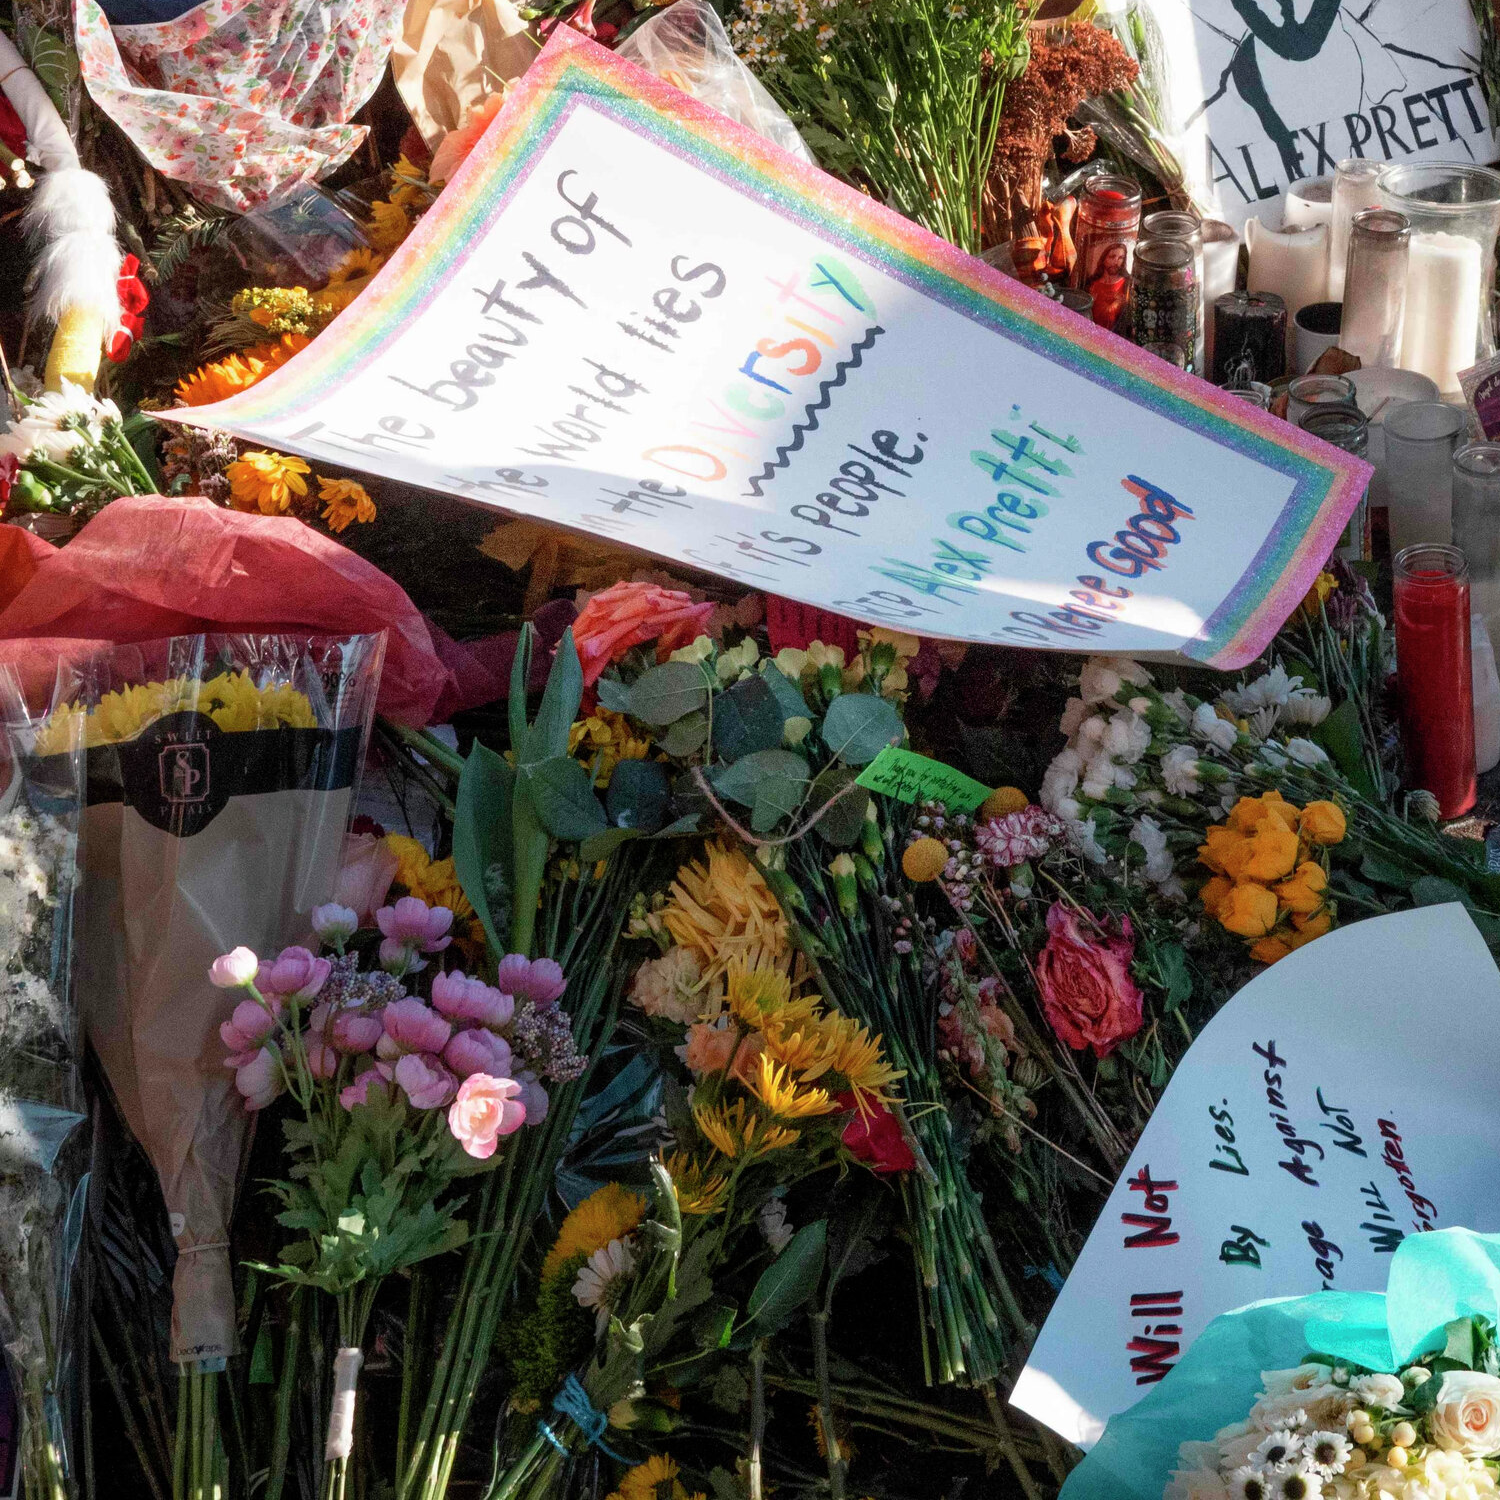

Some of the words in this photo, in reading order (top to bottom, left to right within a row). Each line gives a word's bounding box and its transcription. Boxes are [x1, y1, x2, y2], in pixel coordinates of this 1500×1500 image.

[1208, 122, 1338, 206] ALEX
[1344, 77, 1488, 162] PRETT
[288, 414, 437, 460] The
[388, 251, 588, 412] beauty
[550, 169, 634, 255] of
[515, 356, 651, 462] world
[617, 254, 728, 355] lies
[597, 477, 694, 519] the
[870, 537, 1002, 606] Alex
[947, 404, 1088, 553] Pretti
[1086, 474, 1198, 579] Good
[1209, 1096, 1250, 1178] Lies.
[1252, 1038, 1327, 1188] Against
[1377, 1108, 1439, 1233] orgotten.
[1120, 1163, 1180, 1249] Not
[1218, 1223, 1271, 1271] By
[1126, 1289, 1184, 1387] Will
